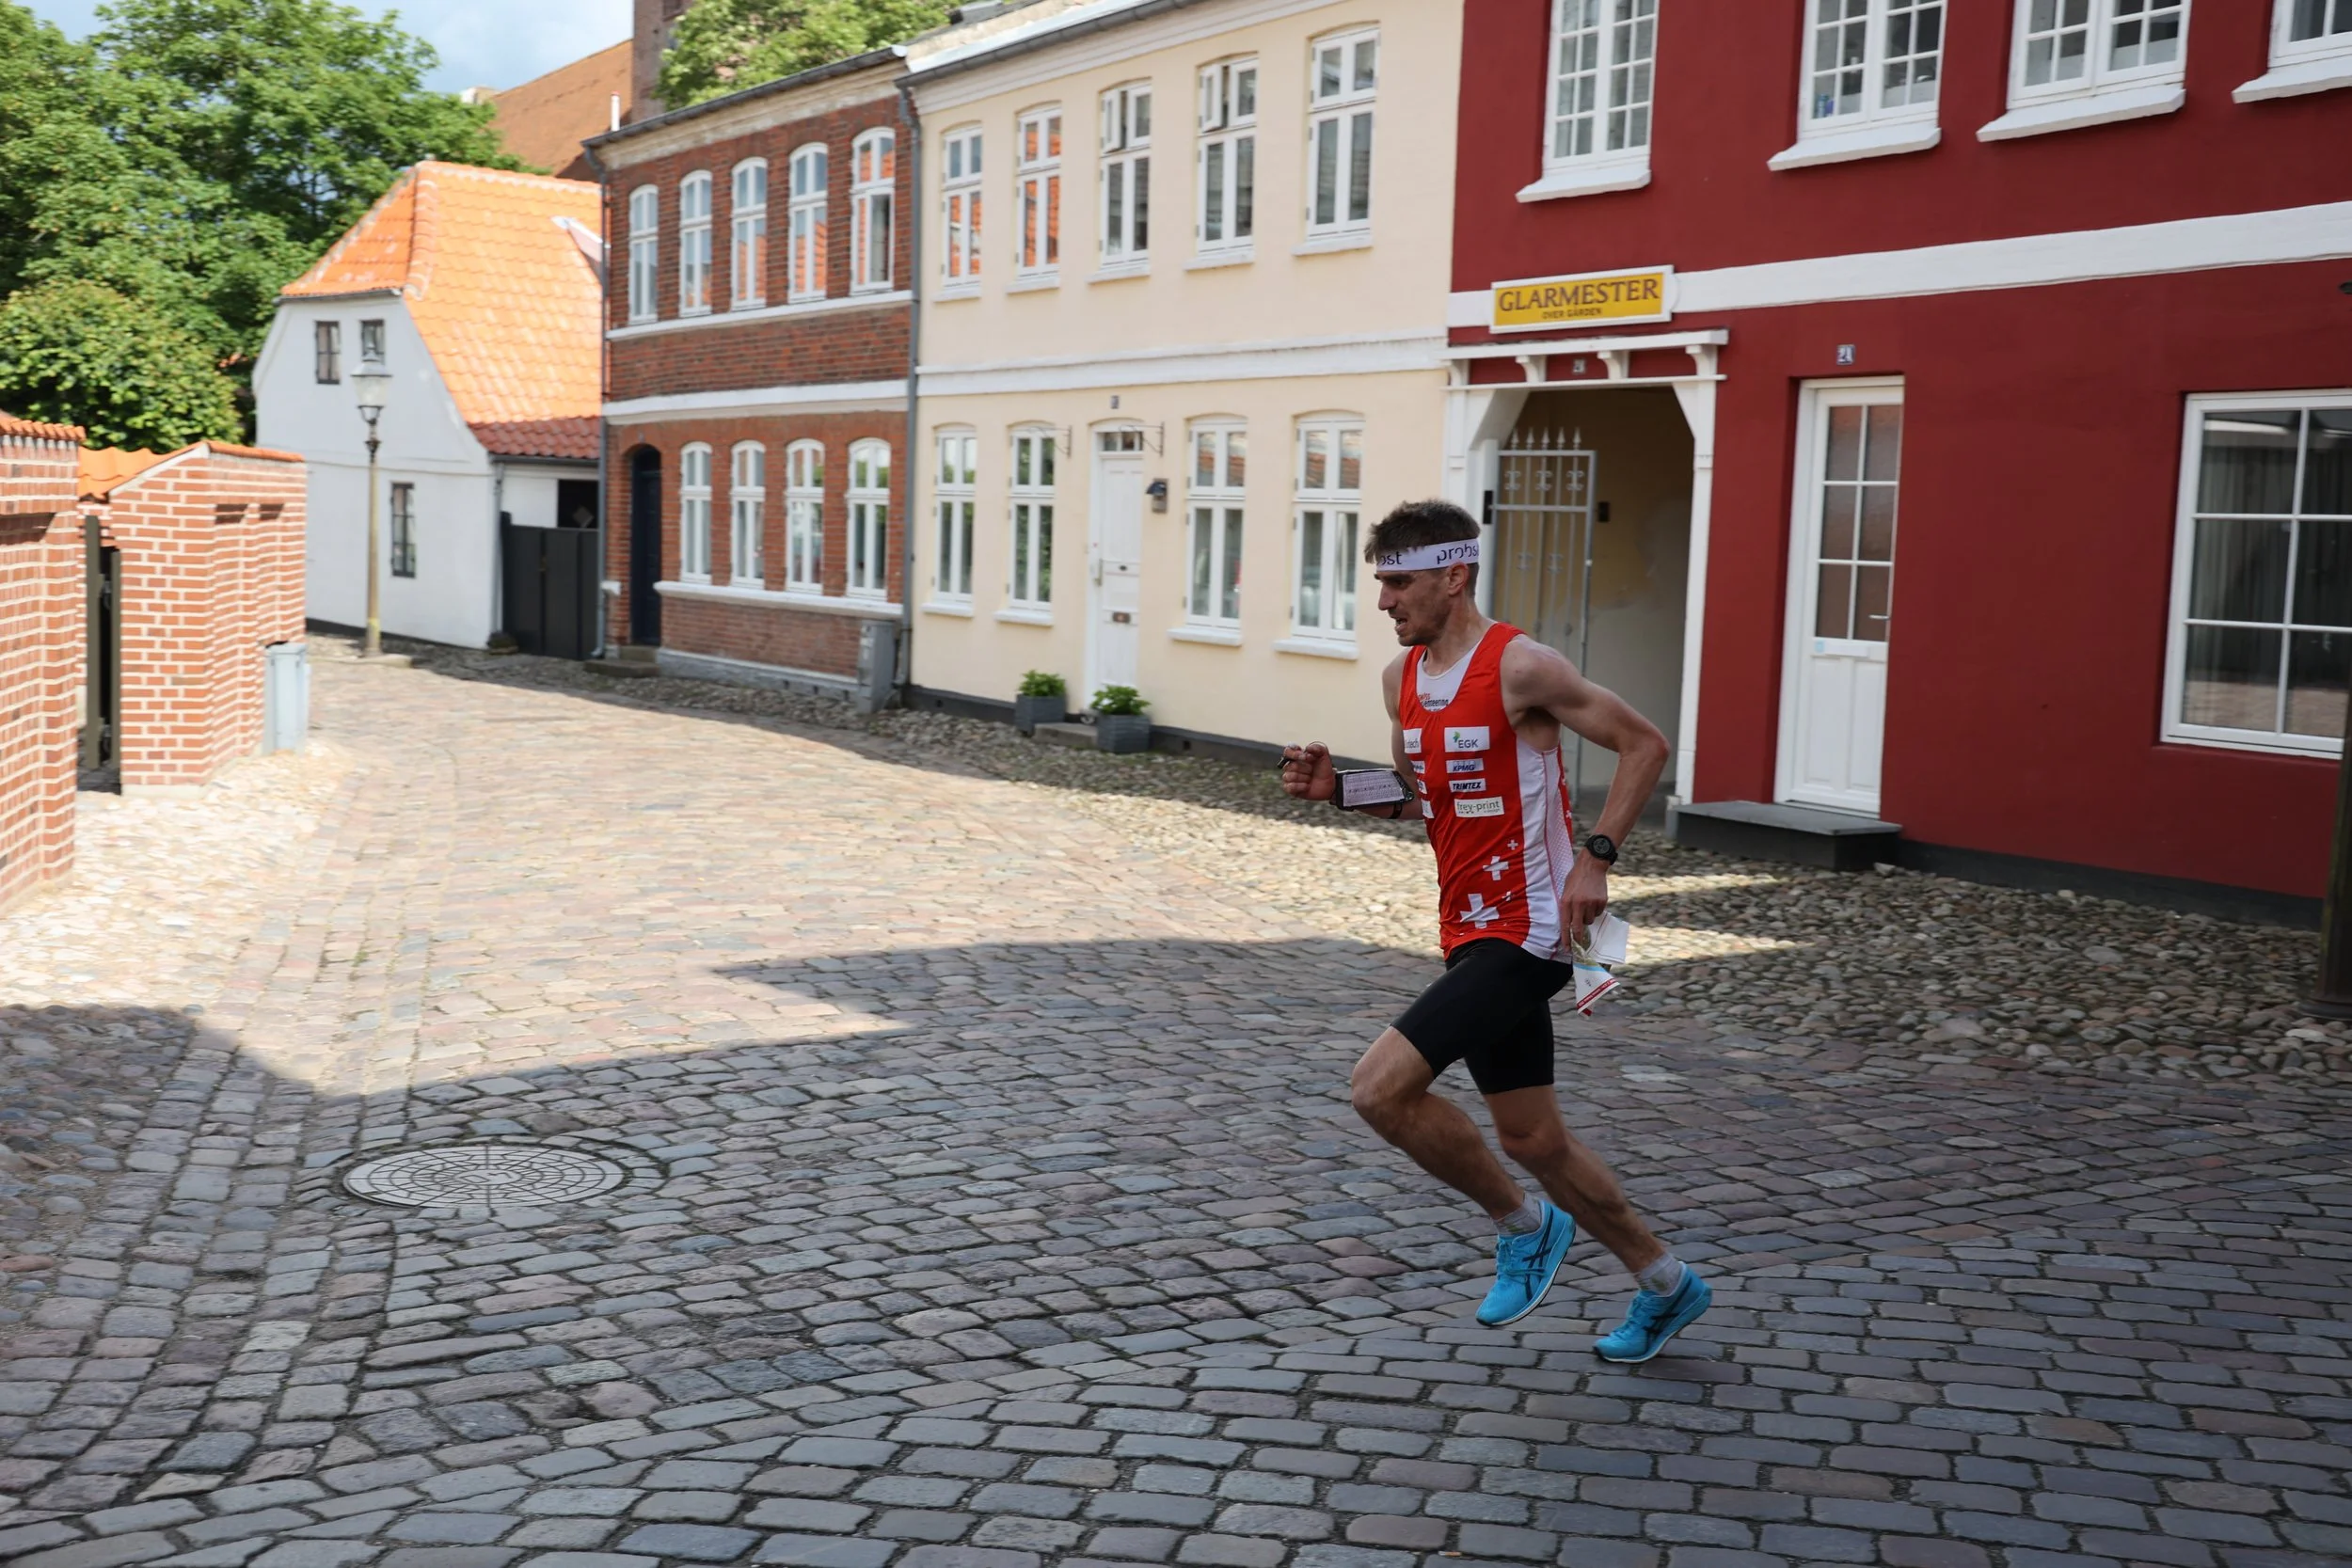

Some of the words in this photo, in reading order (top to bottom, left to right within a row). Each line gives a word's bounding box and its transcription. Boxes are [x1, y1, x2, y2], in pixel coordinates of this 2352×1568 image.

[1499, 278, 1659, 311] GLARMESTER
[1542, 309, 1564, 320] OVER
[1458, 738, 1478, 749] EGK
[1453, 764, 1476, 772] KPMG
[1453, 781, 1482, 790] TRIMTEX
